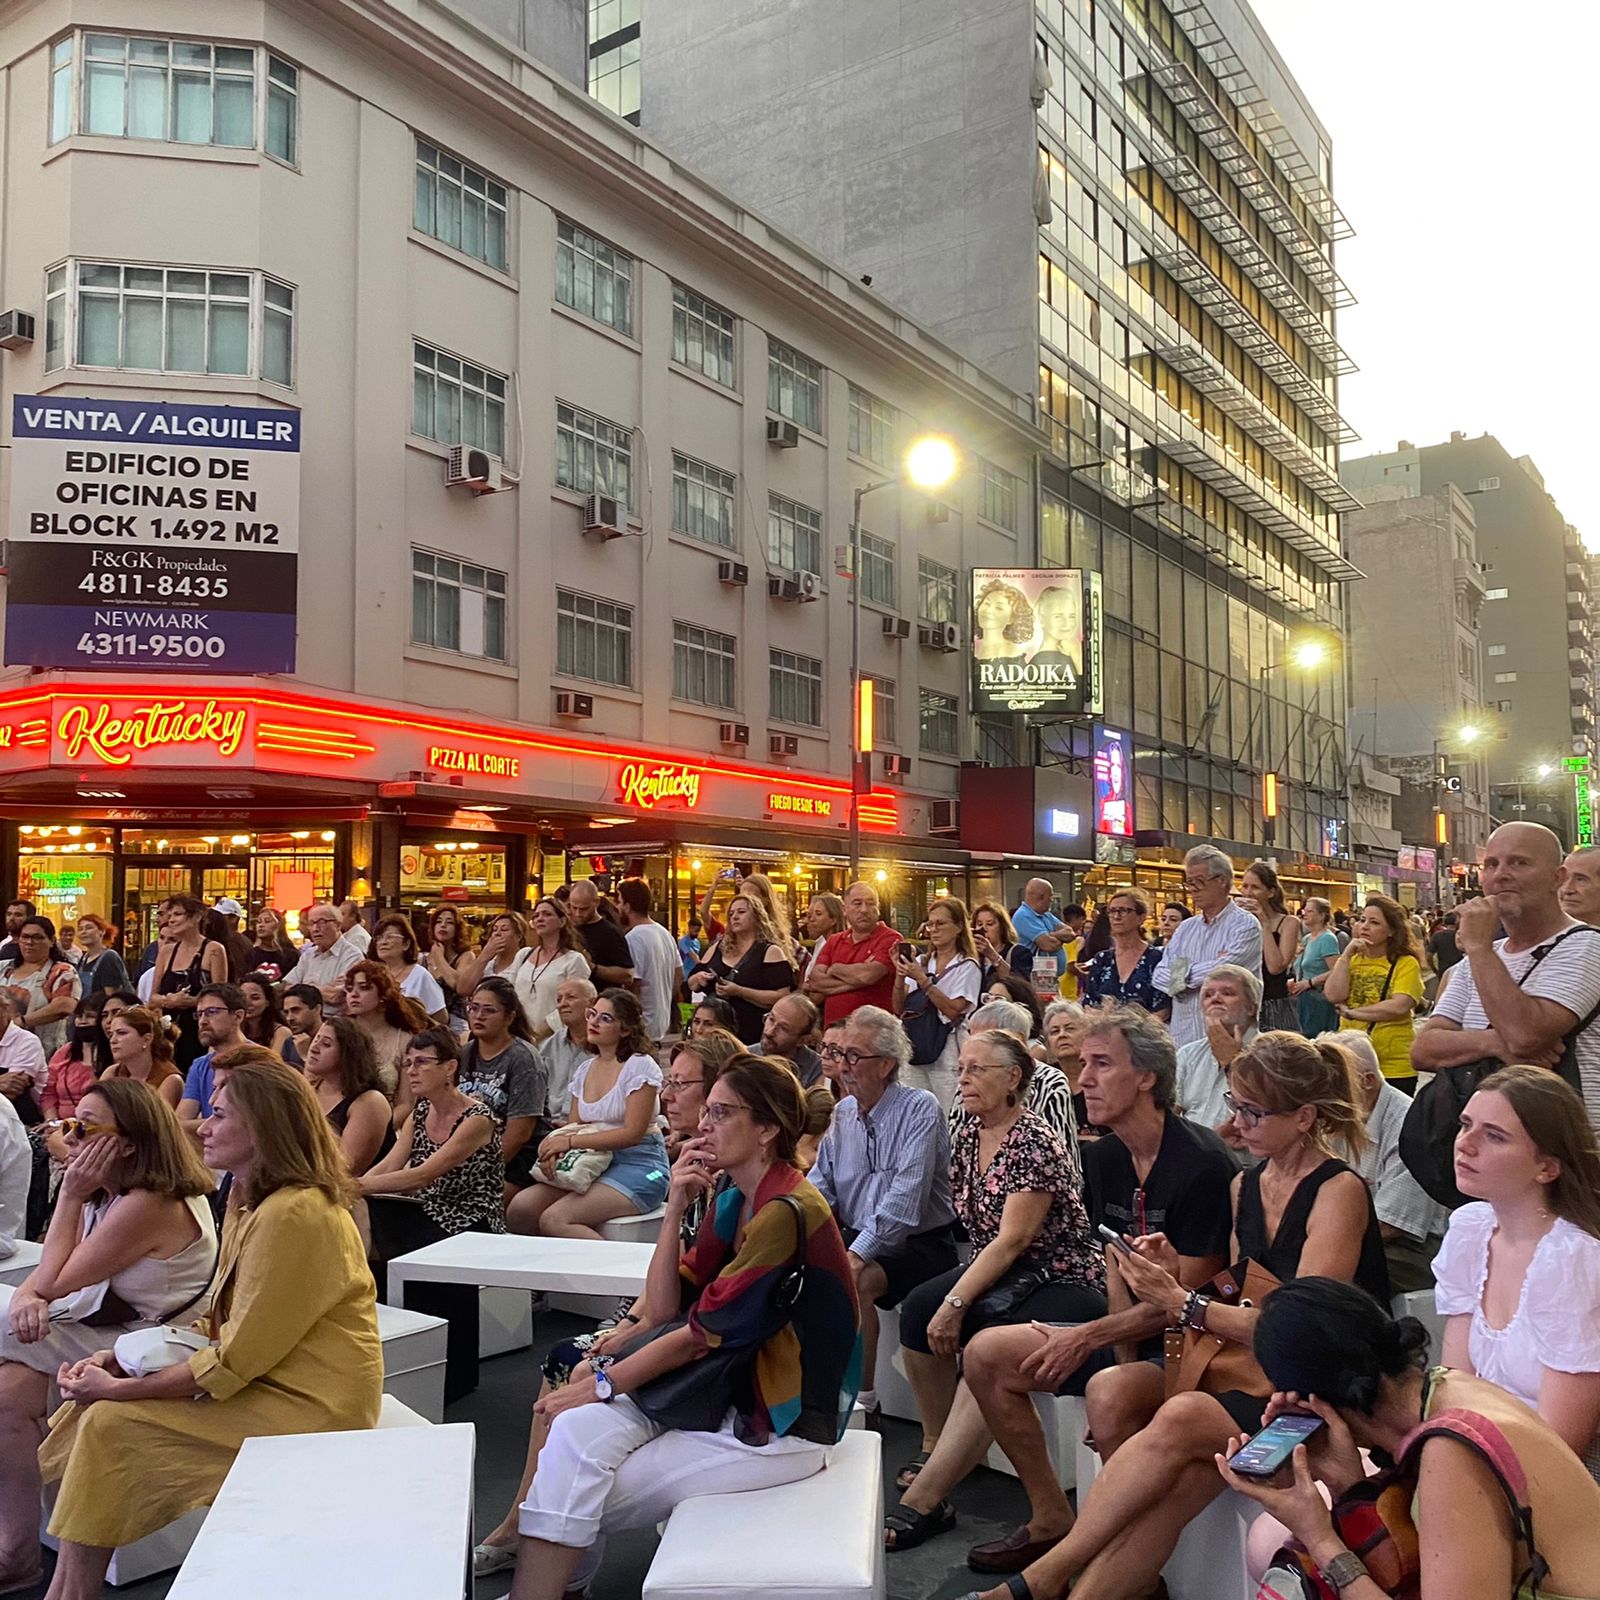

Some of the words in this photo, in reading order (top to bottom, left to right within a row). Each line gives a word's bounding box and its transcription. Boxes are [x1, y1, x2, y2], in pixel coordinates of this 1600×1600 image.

[23, 407, 123, 432] VENTA
[127, 412, 146, 434] /
[149, 414, 293, 441] ALQUILER
[65, 451, 201, 477] EDIFICIO
[208, 458, 249, 481] DE
[56, 482, 208, 509] OFICINAS
[216, 490, 257, 512] EN
[30, 513, 138, 537] BLOCK
[150, 518, 227, 541] 1.492
[235, 522, 279, 545] M2
[91, 550, 154, 569] F&GK
[156, 557, 228, 574] Propiedades
[78, 572, 229, 598] 4811-8435
[94, 611, 209, 630] NEWMARK
[76, 632, 226, 658] 4311-9500
[979, 663, 1076, 684] RADOJKA
[58, 701, 246, 764] Kentucky
[467, 753, 481, 772] AL
[483, 754, 519, 777] CORTE
[621, 764, 699, 808] Kentucky
[769, 794, 792, 810] FUEGO
[792, 796, 814, 813] DESDE
[814, 799, 831, 815] 1942
